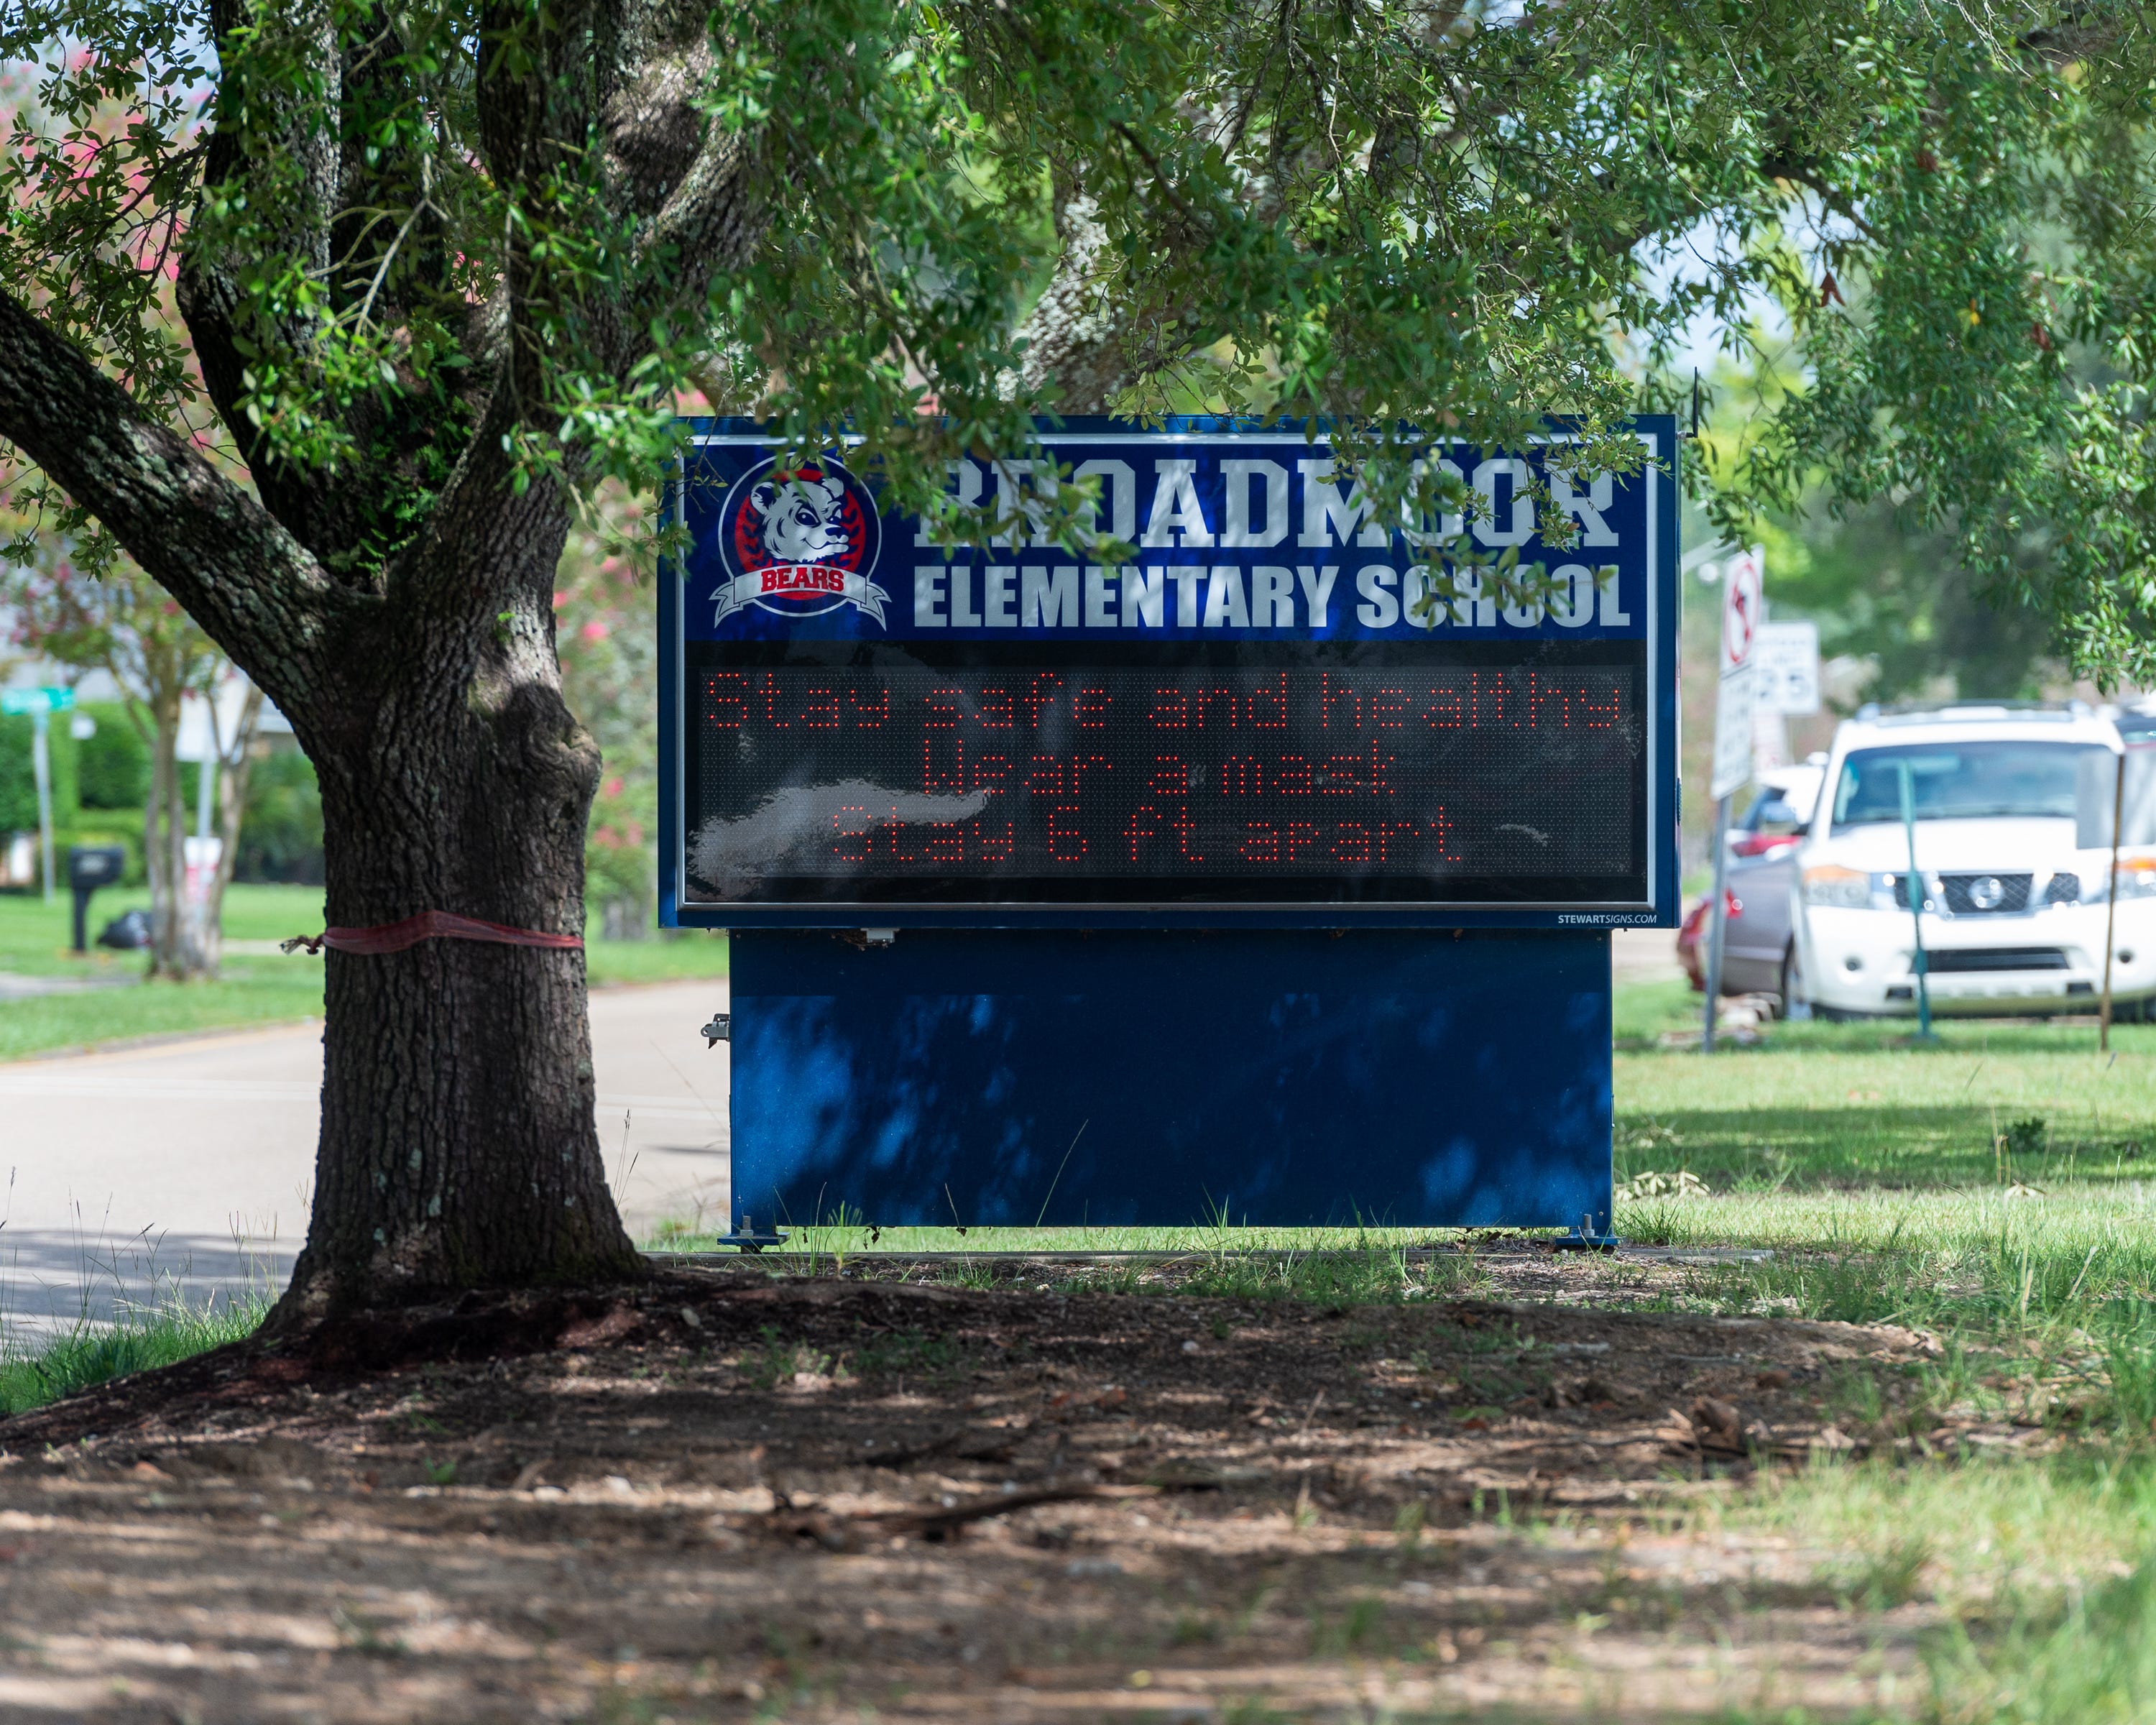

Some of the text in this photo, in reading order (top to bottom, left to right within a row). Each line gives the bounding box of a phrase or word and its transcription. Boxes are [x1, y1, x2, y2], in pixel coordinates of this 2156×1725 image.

[760, 566, 845, 592] BEARS
[914, 564, 1631, 628] ELEMENTARY SCHOOL
[709, 672, 1618, 727] Stay safe and healthy
[924, 739, 1394, 794] Wear a mask
[833, 805, 1460, 861] Stay 6 ft apart
[1557, 914, 1657, 924] STEWARTSIGNS.COM
